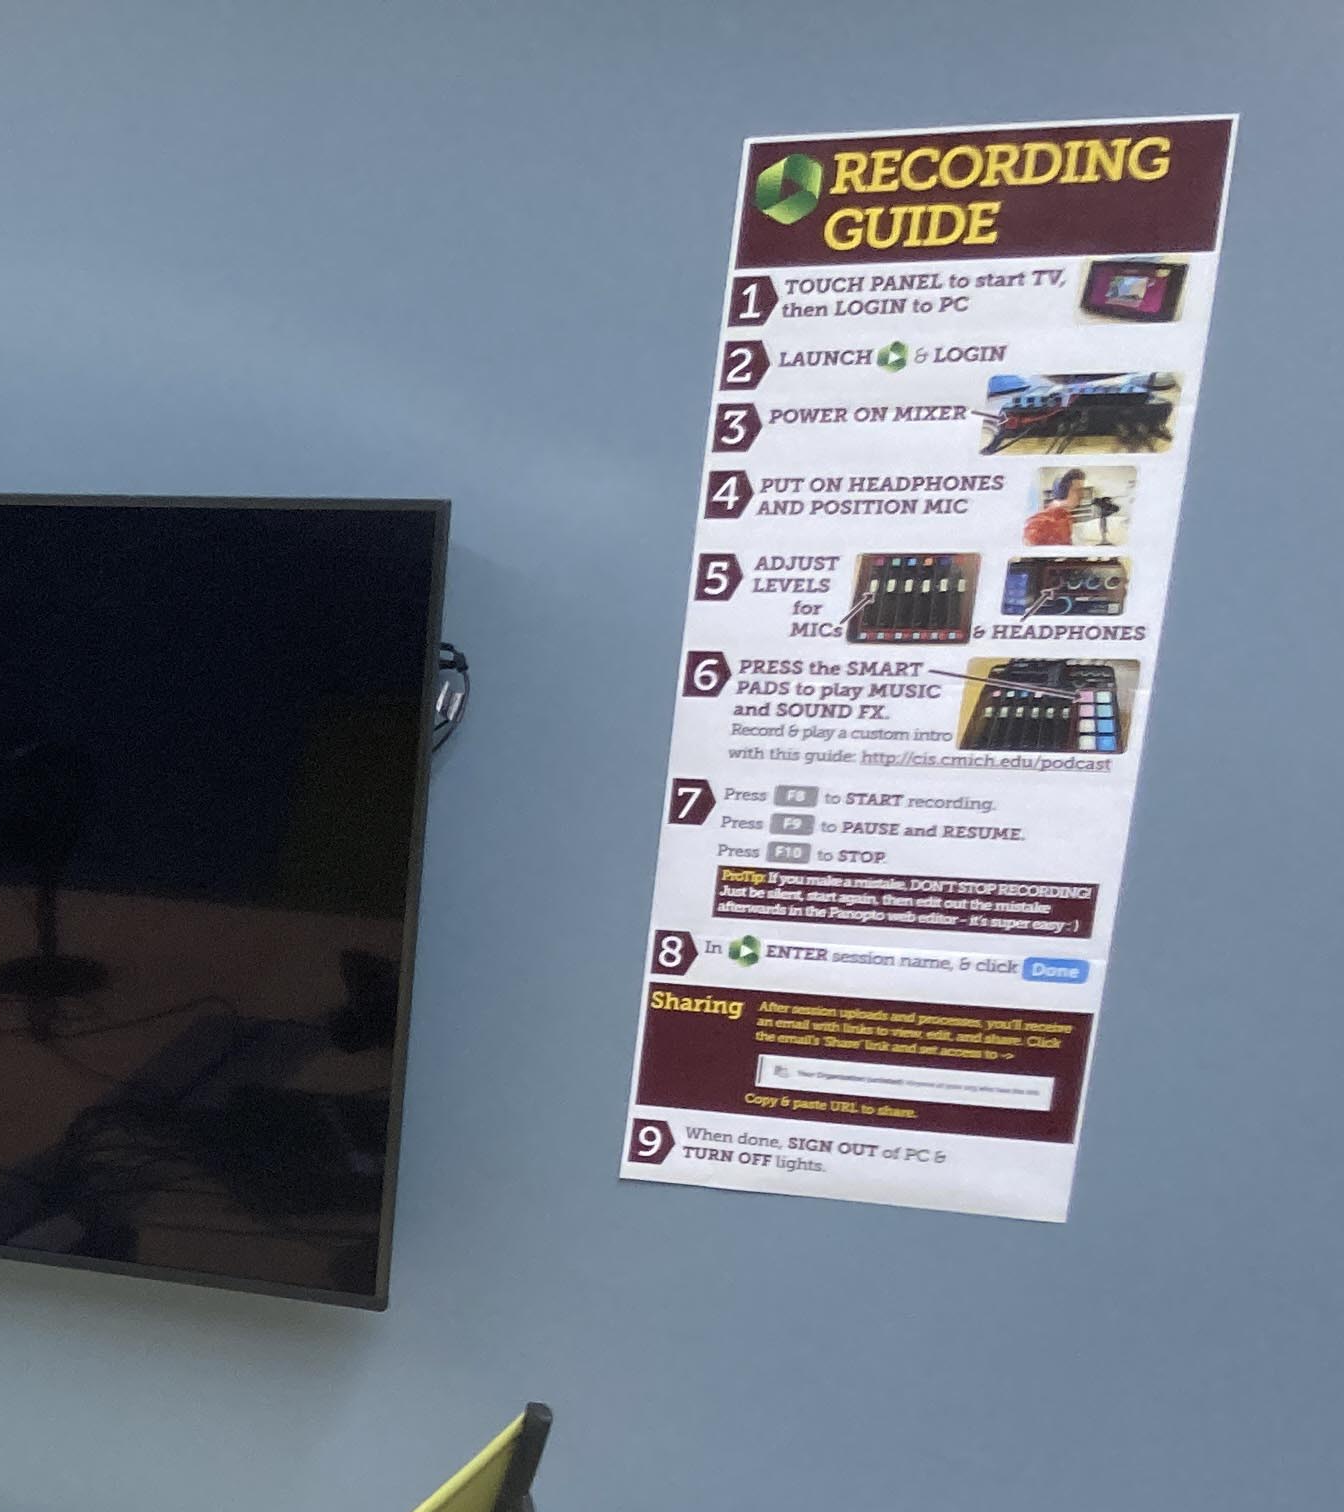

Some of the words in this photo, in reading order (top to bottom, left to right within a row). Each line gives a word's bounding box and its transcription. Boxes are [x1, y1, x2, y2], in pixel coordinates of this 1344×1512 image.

[830, 137, 1171, 195] RECORDING
[824, 202, 1001, 250] GUIDE
[785, 278, 863, 295] TOUCH
[872, 274, 942, 291] PANEL
[950, 274, 969, 288] to
[975, 272, 1024, 287] start
[1032, 269, 1066, 287] TV,
[739, 284, 762, 319] 1
[782, 302, 827, 317] then
[835, 299, 906, 315] LOGIN
[913, 297, 932, 313] to
[939, 296, 969, 313] PC
[726, 347, 752, 382] 2
[779, 349, 872, 366] LAUNCH
[934, 345, 1007, 363] LOGIN
[720, 411, 744, 444] 3
[769, 408, 848, 424] POWER
[854, 407, 886, 421] ON
[895, 406, 966, 421] MIXER
[712, 478, 741, 510] 4
[761, 478, 803, 493] PUT
[811, 477, 843, 492] ON
[849, 475, 1005, 491] HEADPHONES
[756, 500, 803, 515] AND
[810, 499, 916, 515] POSITION
[925, 499, 969, 514] MIC
[755, 557, 839, 571] ADJUST
[703, 562, 728, 594] 5
[752, 578, 830, 593] LEVELS
[793, 601, 821, 615] for
[790, 623, 842, 637] MICs
[992, 626, 1146, 640] HEADPHONES
[693, 659, 717, 690] 6
[738, 660, 802, 675] PRESS
[810, 662, 840, 676] the
[848, 662, 923, 677] SMART
[736, 682, 790, 695] PADS
[796, 683, 816, 696] to
[822, 683, 862, 700] play
[869, 684, 941, 698] MUSIC
[733, 704, 770, 717] and
[776, 703, 851, 718] SOUND
[858, 706, 889, 719] FX.
[732, 724, 784, 737] Record
[802, 726, 834, 743] play
[838, 731, 847, 740] a
[850, 728, 907, 740] custom
[912, 729, 952, 742] intro
[728, 747, 764, 759] with
[769, 748, 800, 760] this
[804, 749, 856, 764] guide:
[860, 751, 1111, 771] http://cis.cmich.edu/podcast
[677, 787, 702, 818] 7
[724, 788, 766, 802] Press
[825, 791, 841, 805] to
[846, 793, 904, 806] START
[908, 796, 996, 813] recording.
[721, 816, 762, 830] Press
[783, 817, 802, 830] F9
[822, 820, 837, 833] to
[842, 822, 899, 836] PAUSE
[904, 824, 937, 836] and
[943, 826, 1025, 841] RESUME.
[718, 844, 759, 858] Press
[775, 845, 802, 859] F10
[818, 848, 833, 862] to
[779, 875, 804, 886] you
[807, 875, 842, 886] make
[844, 879, 852, 887] a
[958, 881, 996, 895] STOP
[999, 883, 1092, 899] RECORDING!
[720, 886, 746, 897] Just
[749, 887, 764, 898] be
[767, 889, 804, 901] silent,
[807, 891, 836, 901] start
[882, 894, 914, 907] then
[916, 897, 942, 907] edit
[944, 898, 968, 909] out
[970, 899, 992, 910] the
[995, 901, 1051, 914] mistake
[718, 902, 786, 915] afterwards
[789, 905, 803, 916] in
[805, 906, 826, 917] the
[829, 907, 885, 922] Panopto
[887, 911, 916, 922] web
[918, 913, 958, 924] editor
[990, 918, 1029, 930] super
[658, 936, 684, 967] 8
[705, 940, 722, 955] In
[766, 946, 828, 960] ENTER
[832, 949, 894, 964] session
[900, 955, 953, 970] name,
[975, 957, 1018, 973] click
[1032, 962, 1080, 978] Done
[651, 991, 744, 1017] Sharing
[744, 1093, 778, 1107] Copy
[792, 1100, 827, 1112] paste
[830, 1101, 858, 1112] URL
[861, 1105, 875, 1114] to
[637, 1126, 662, 1157] 9
[686, 1127, 733, 1143] When
[737, 1132, 784, 1149] done,
[788, 1136, 833, 1152] SIGN
[838, 1140, 878, 1157] OUT
[882, 1146, 900, 1159] of
[904, 1149, 930, 1163] PC
[683, 1146, 733, 1162] TURN
[738, 1151, 772, 1167] OFF
[776, 1155, 826, 1172] lights.
